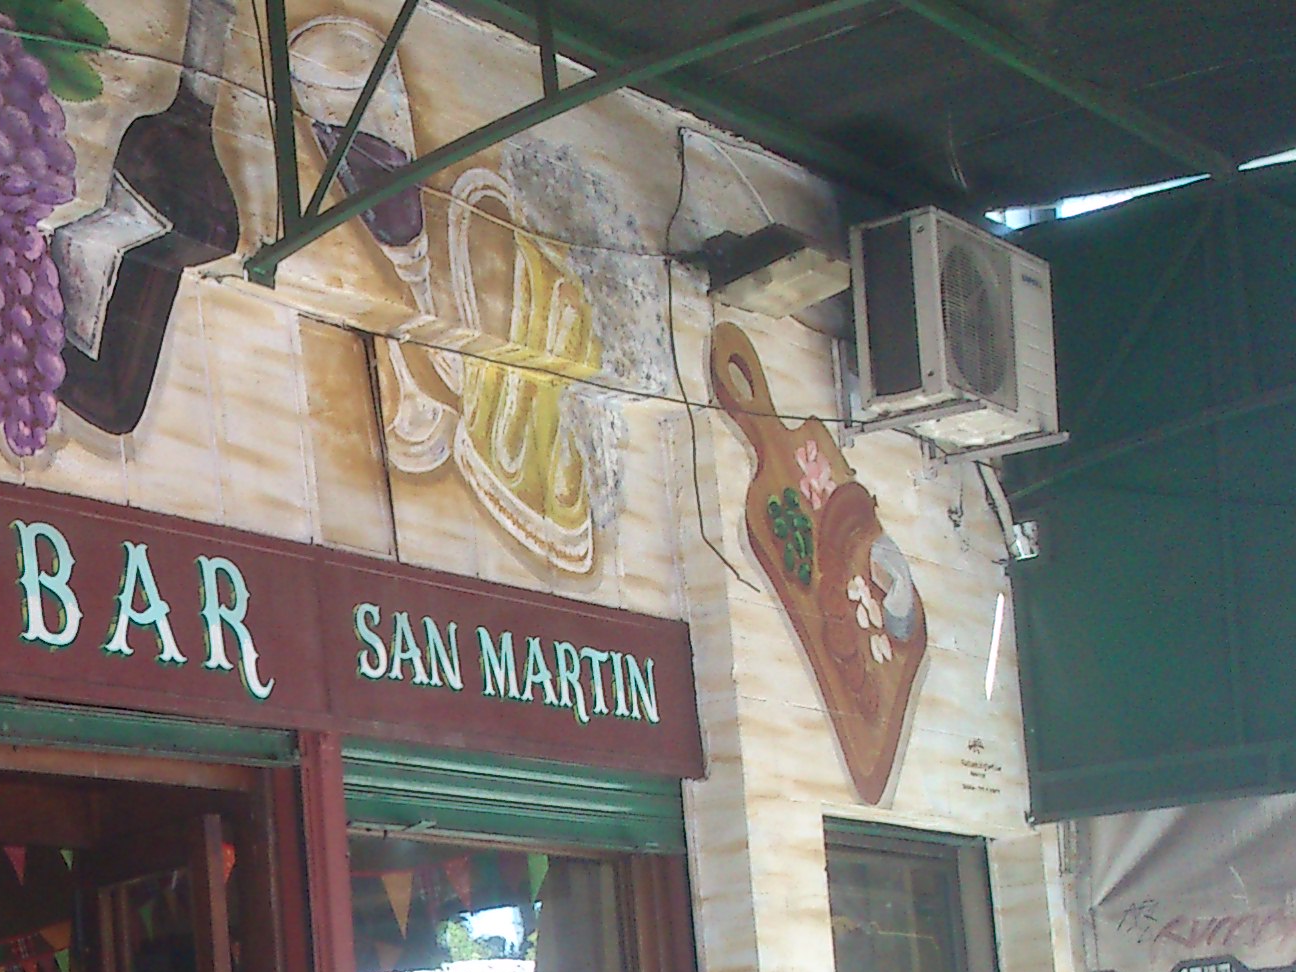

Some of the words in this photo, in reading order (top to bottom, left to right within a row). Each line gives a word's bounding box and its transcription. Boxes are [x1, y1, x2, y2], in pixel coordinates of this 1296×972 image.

[11, 519, 275, 700] BAR
[354, 602, 464, 692] SAN
[476, 626, 661, 724] MARTIN
